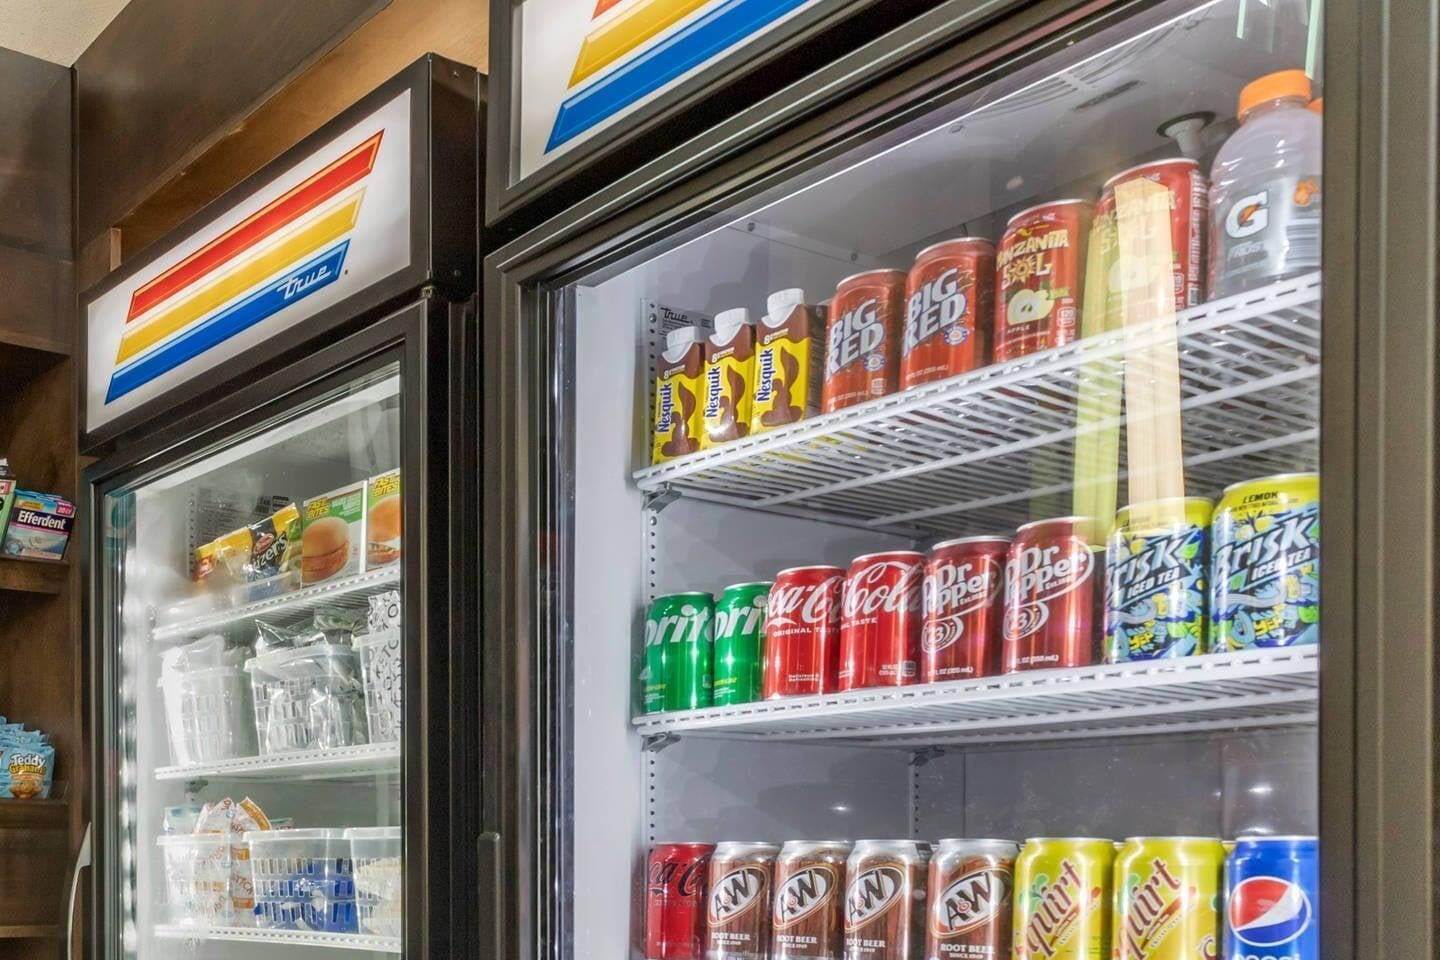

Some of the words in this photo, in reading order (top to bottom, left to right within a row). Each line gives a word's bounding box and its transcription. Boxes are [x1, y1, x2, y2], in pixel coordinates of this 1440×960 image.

[1226, 192, 1267, 238] G
[909, 268, 958, 325] BIG
[830, 299, 876, 348] BIG
[903, 293, 967, 358] RED
[757, 348, 773, 401] Nesquik
[826, 322, 884, 383] RED
[657, 382, 673, 433] Nesquik
[706, 366, 721, 418] Nesquik
[18, 510, 66, 529] Efferdent
[1242, 490, 1279, 504] LEMON
[936, 563, 972, 592] Dr
[1005, 553, 1087, 606] Pepper
[1020, 546, 1059, 572] Dr
[1127, 578, 1155, 598] ICED
[1157, 567, 1181, 587] TEA
[1252, 559, 1284, 583] ICED
[1286, 548, 1311, 568] TEA
[922, 568, 997, 619] Pepper
[773, 628, 811, 637] ORIGINAL
[11, 753, 46, 767] Teddy
[713, 870, 750, 922] A&W
[781, 870, 818, 922] A&W
[848, 870, 886, 925] A&W
[946, 871, 992, 931] A&W
[730, 933, 751, 941] BEER
[795, 936, 818, 944] BEER
[864, 939, 886, 948] BEER
[968, 945, 994, 954] BEER
